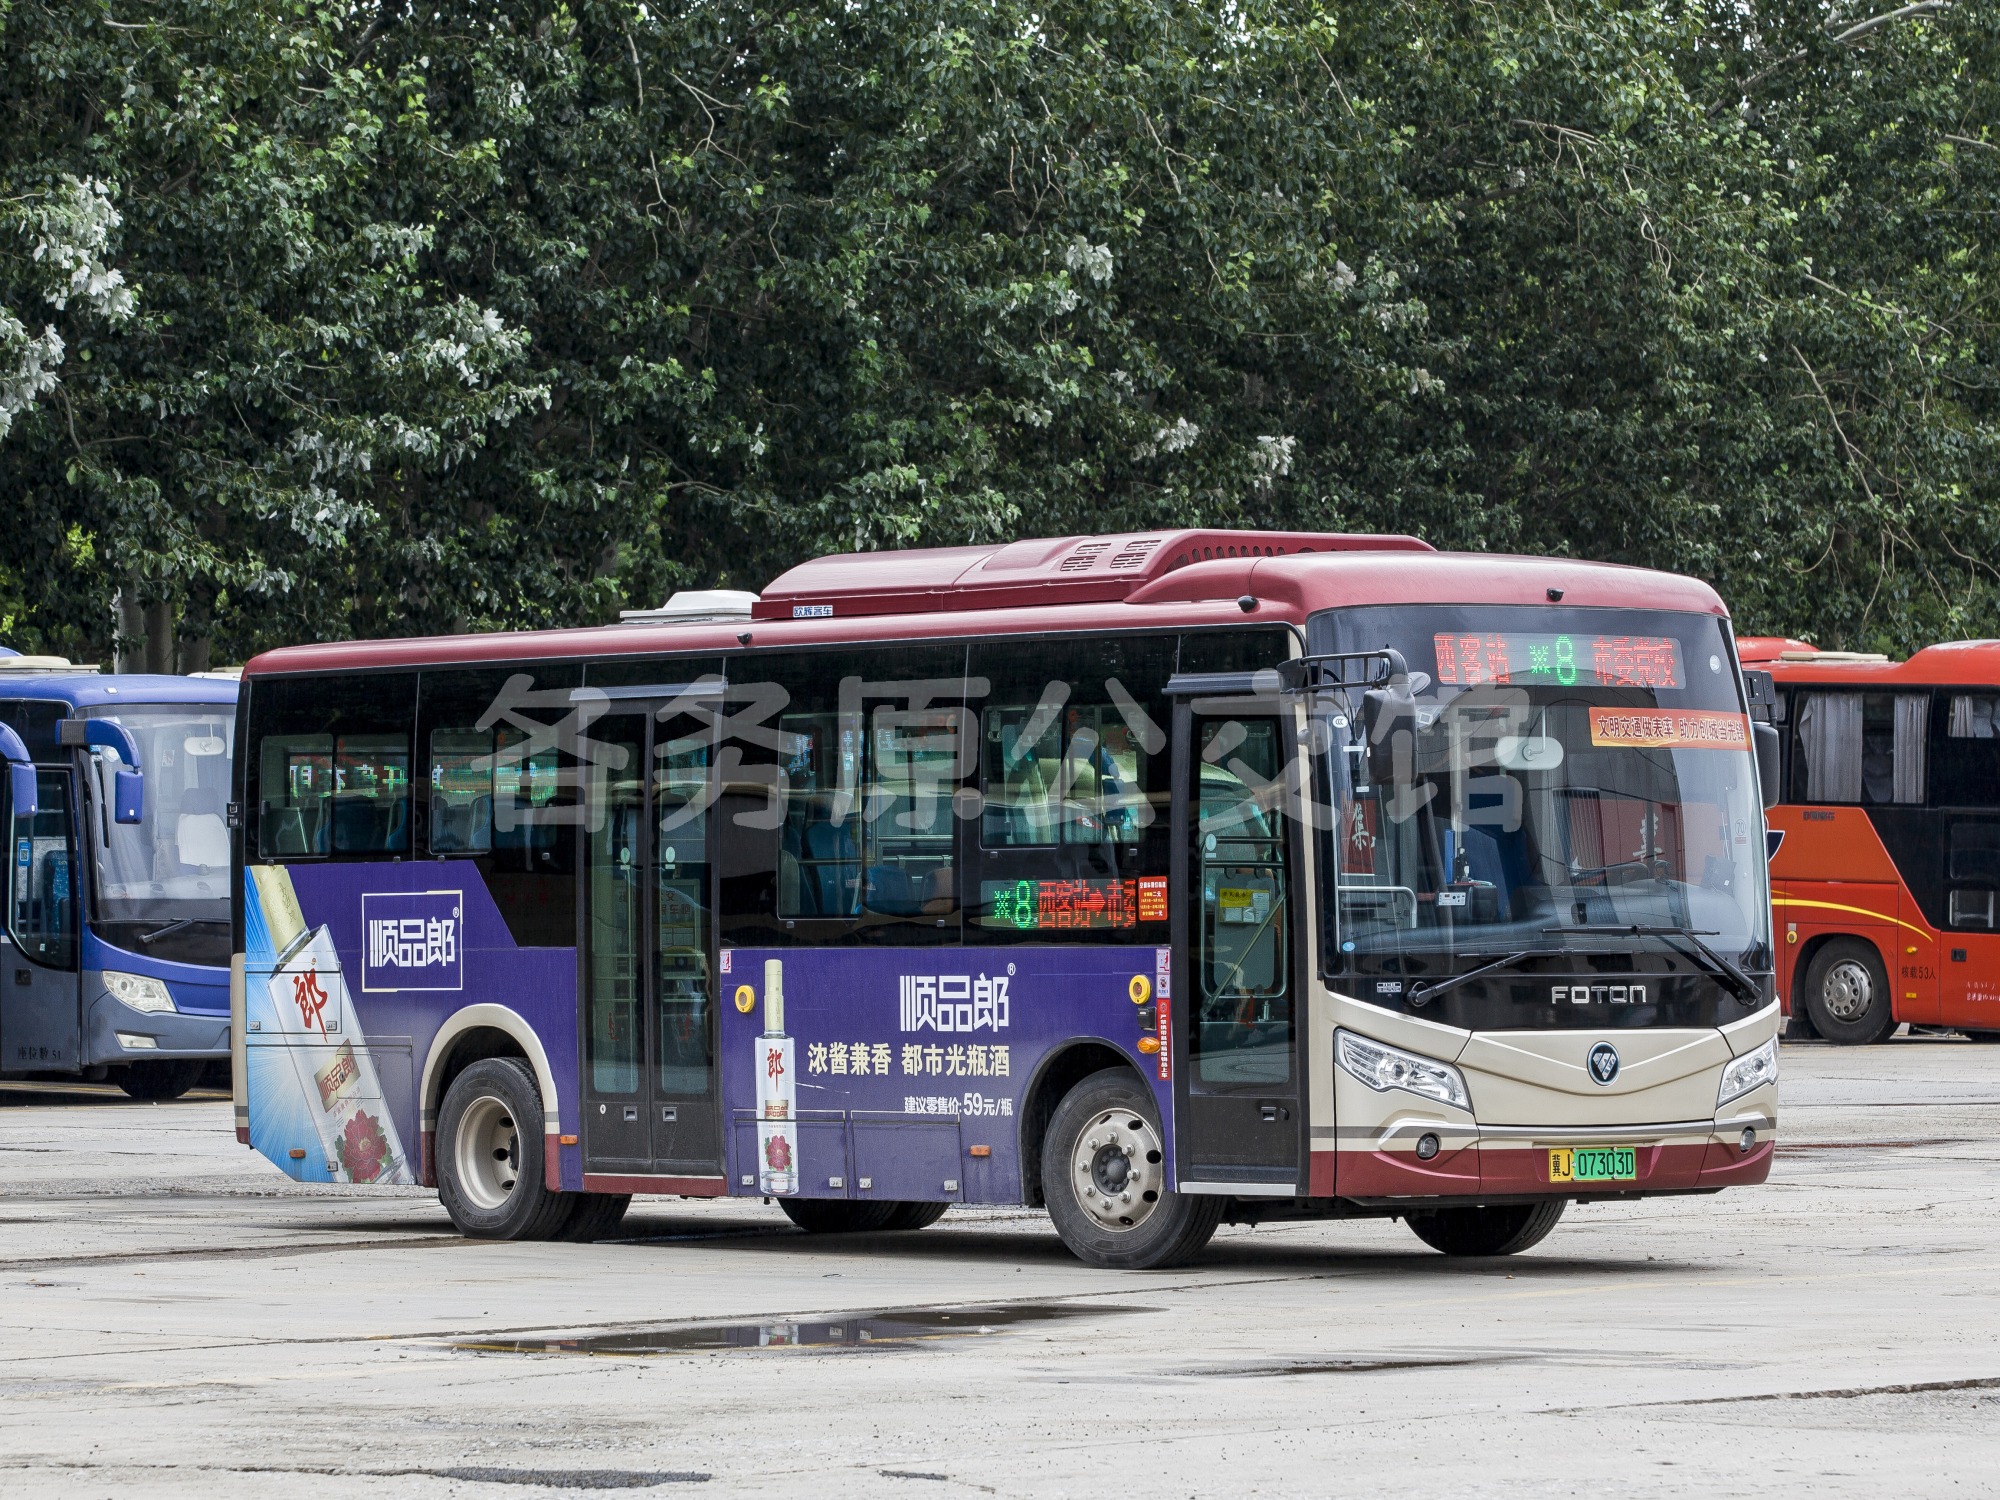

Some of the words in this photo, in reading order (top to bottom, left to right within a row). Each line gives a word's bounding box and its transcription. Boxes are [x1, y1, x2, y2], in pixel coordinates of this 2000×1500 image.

[1434, 634, 1511, 684] 西客站
[1598, 716, 1674, 740] 文明交通做表率
[1679, 718, 1745, 743] 助力创城当先锋
[369, 916, 455, 967] 顺品郎
[293, 968, 328, 1044] 郎
[900, 972, 1009, 1032] 顺品郎
[1551, 985, 1647, 1004] FOTON
[807, 1042, 892, 1076] 浓酱兼香
[901, 1043, 1010, 1076] 都市光瓶酒
